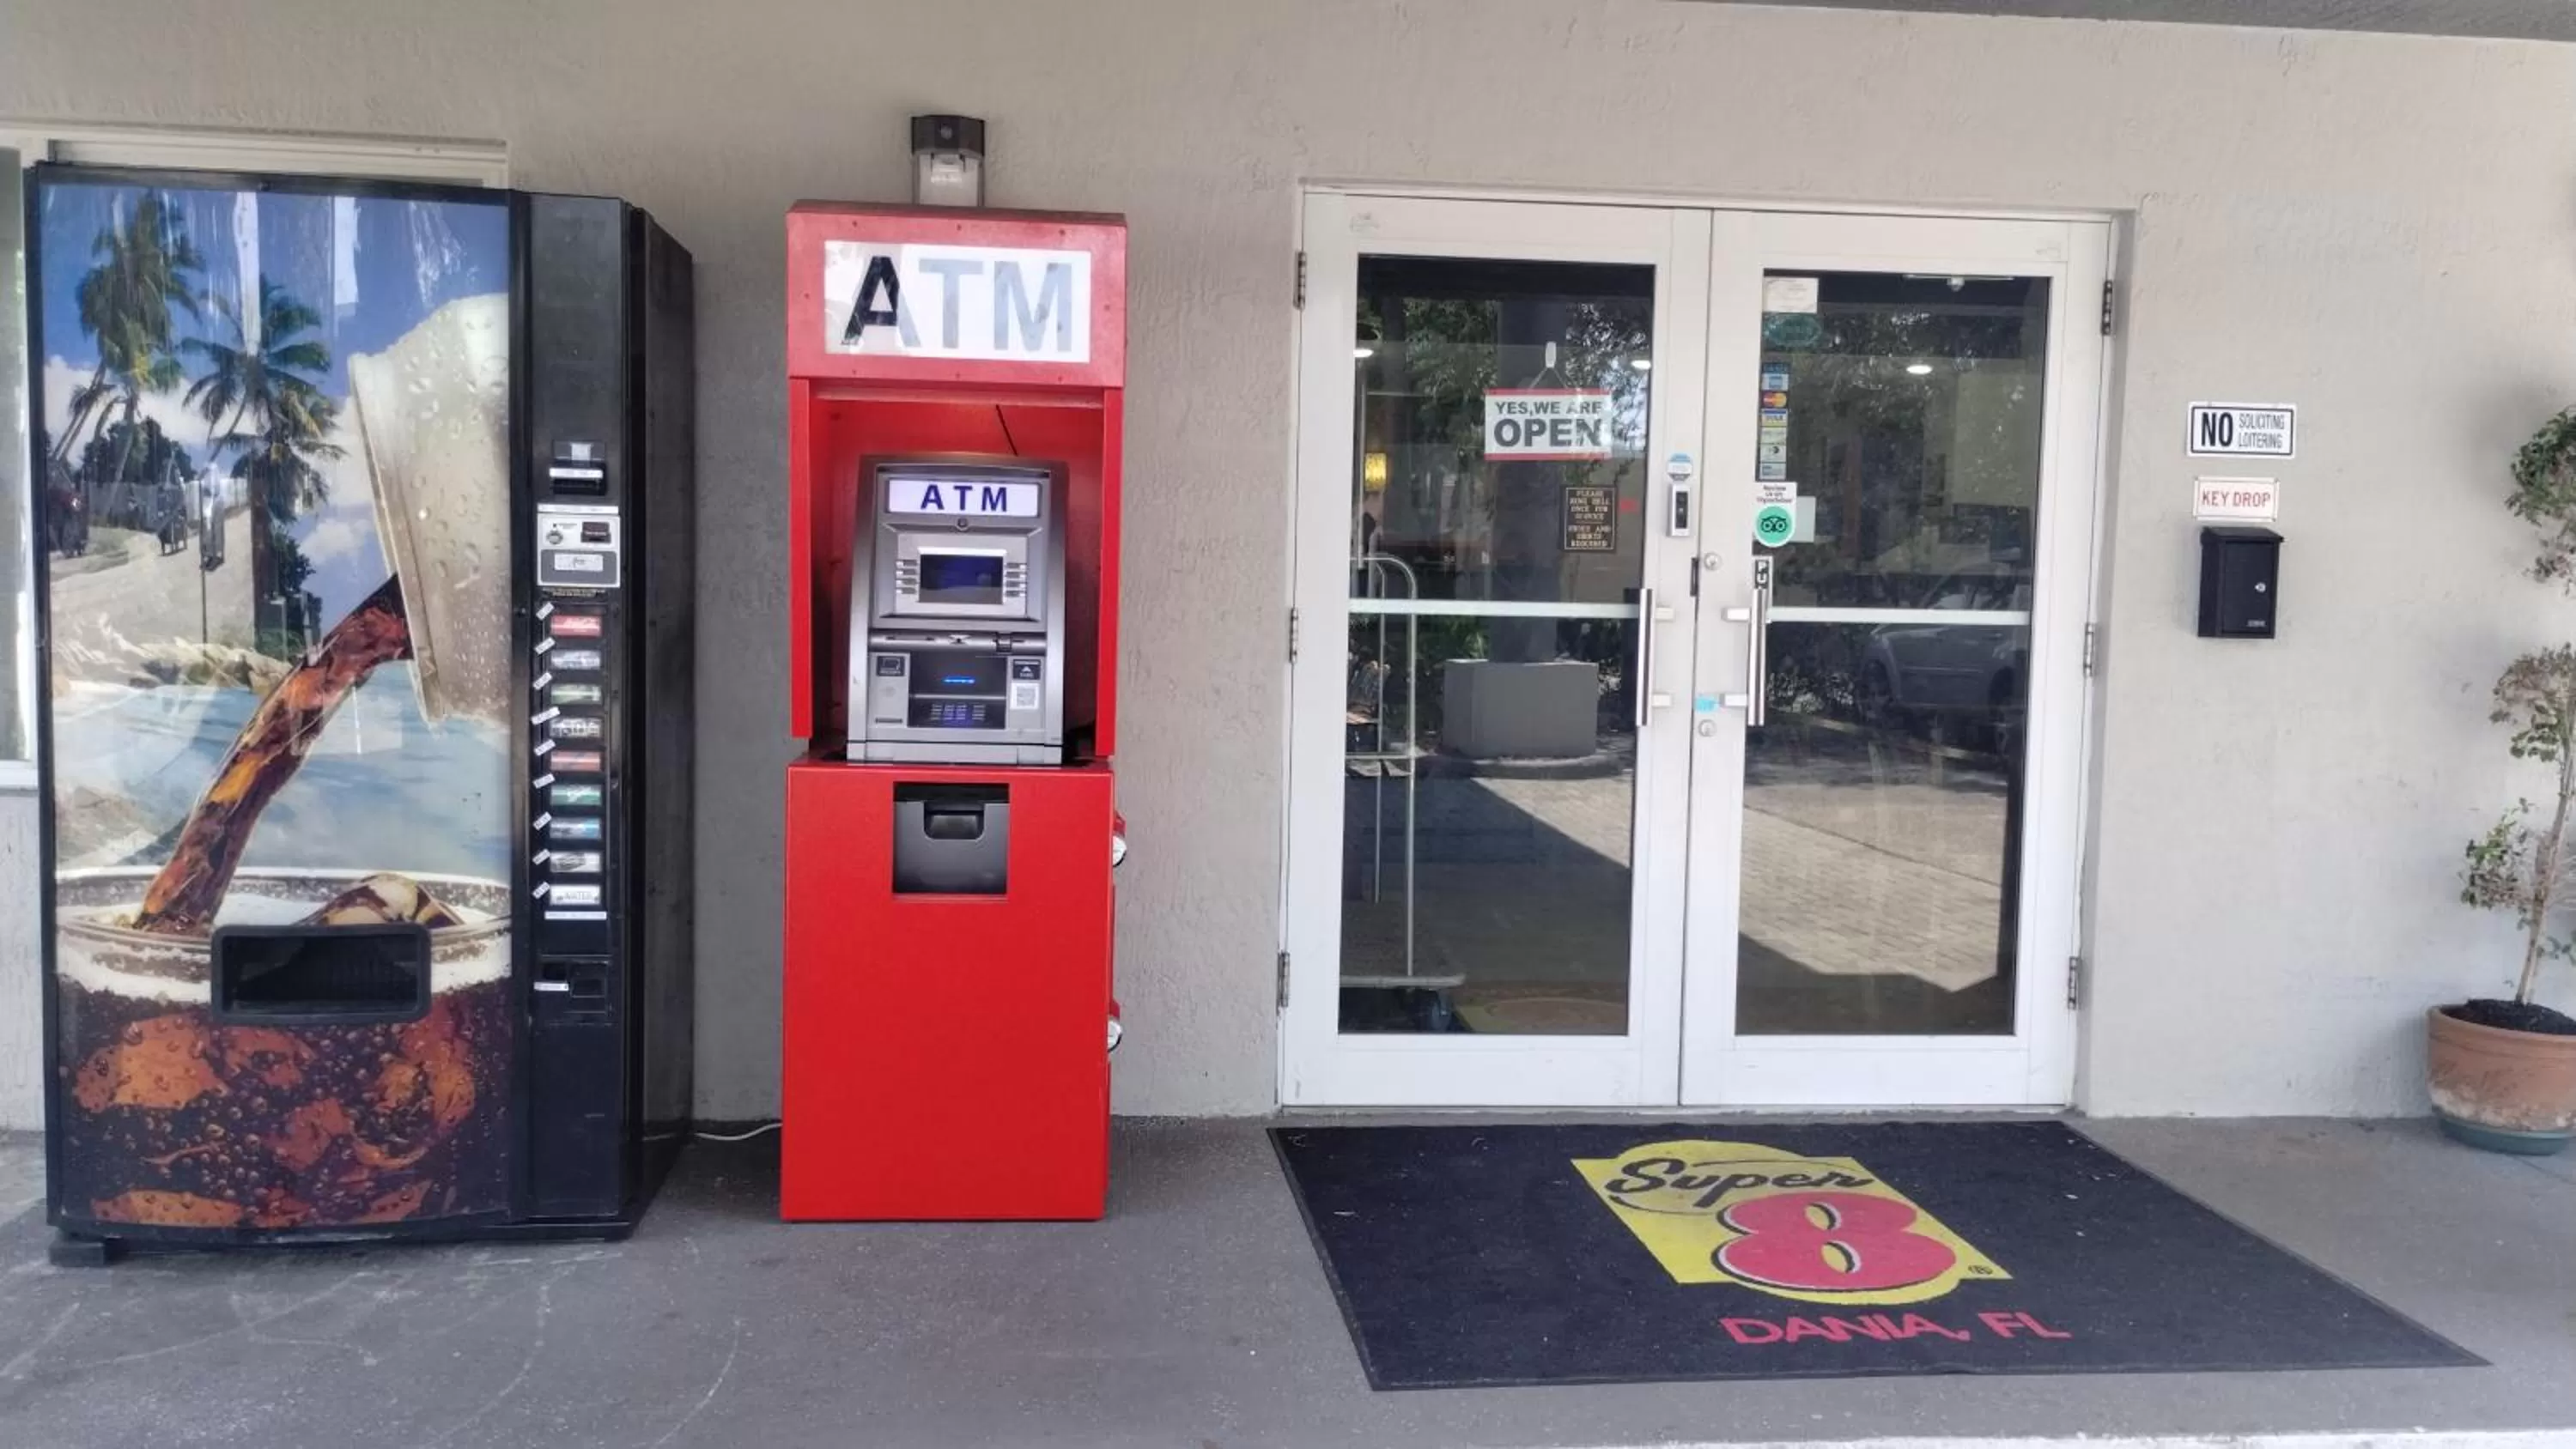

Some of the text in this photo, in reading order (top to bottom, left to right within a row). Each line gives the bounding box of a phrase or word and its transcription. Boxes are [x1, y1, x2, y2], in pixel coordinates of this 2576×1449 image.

[841, 255, 1072, 353] ATM
[1565, 401, 1601, 415] ARE
[2239, 413, 2285, 430] SOLICITING
[1494, 418, 1601, 447] OPEN
[2201, 412, 2233, 446] NO
[2239, 432, 2283, 449] LOITERING
[920, 484, 1007, 512] ATM
[2202, 490, 2271, 508] KEY DROP
[1604, 1158, 1874, 1209] Super
[1710, 1191, 1957, 1292] 8
[1978, 1312, 2072, 1339] FL
